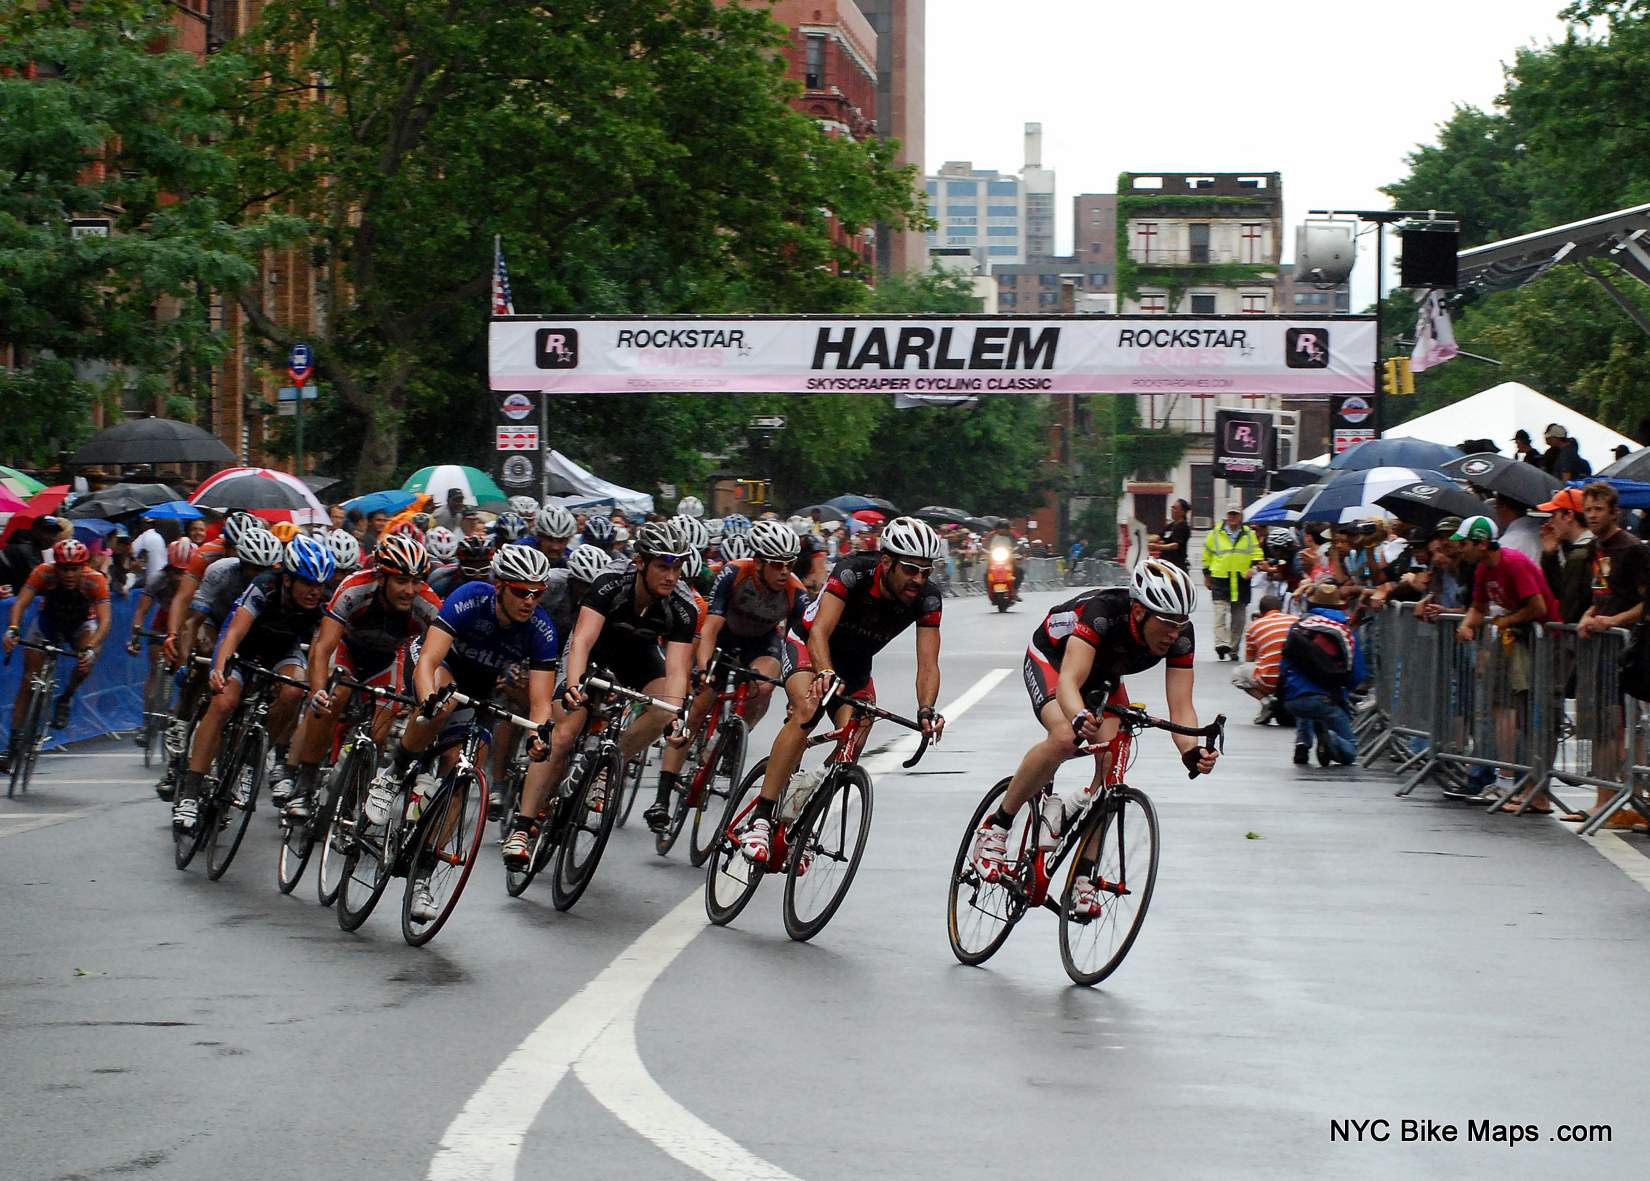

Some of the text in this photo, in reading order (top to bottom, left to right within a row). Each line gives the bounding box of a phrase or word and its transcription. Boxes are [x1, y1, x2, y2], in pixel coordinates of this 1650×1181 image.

[617, 329, 744, 349] ROCKSTAR
[811, 327, 1061, 370] HARLEM
[1118, 329, 1247, 349] ROCKSTAR
[807, 378, 1052, 391] SKYSCRAPER CYCLING CLASSIC
